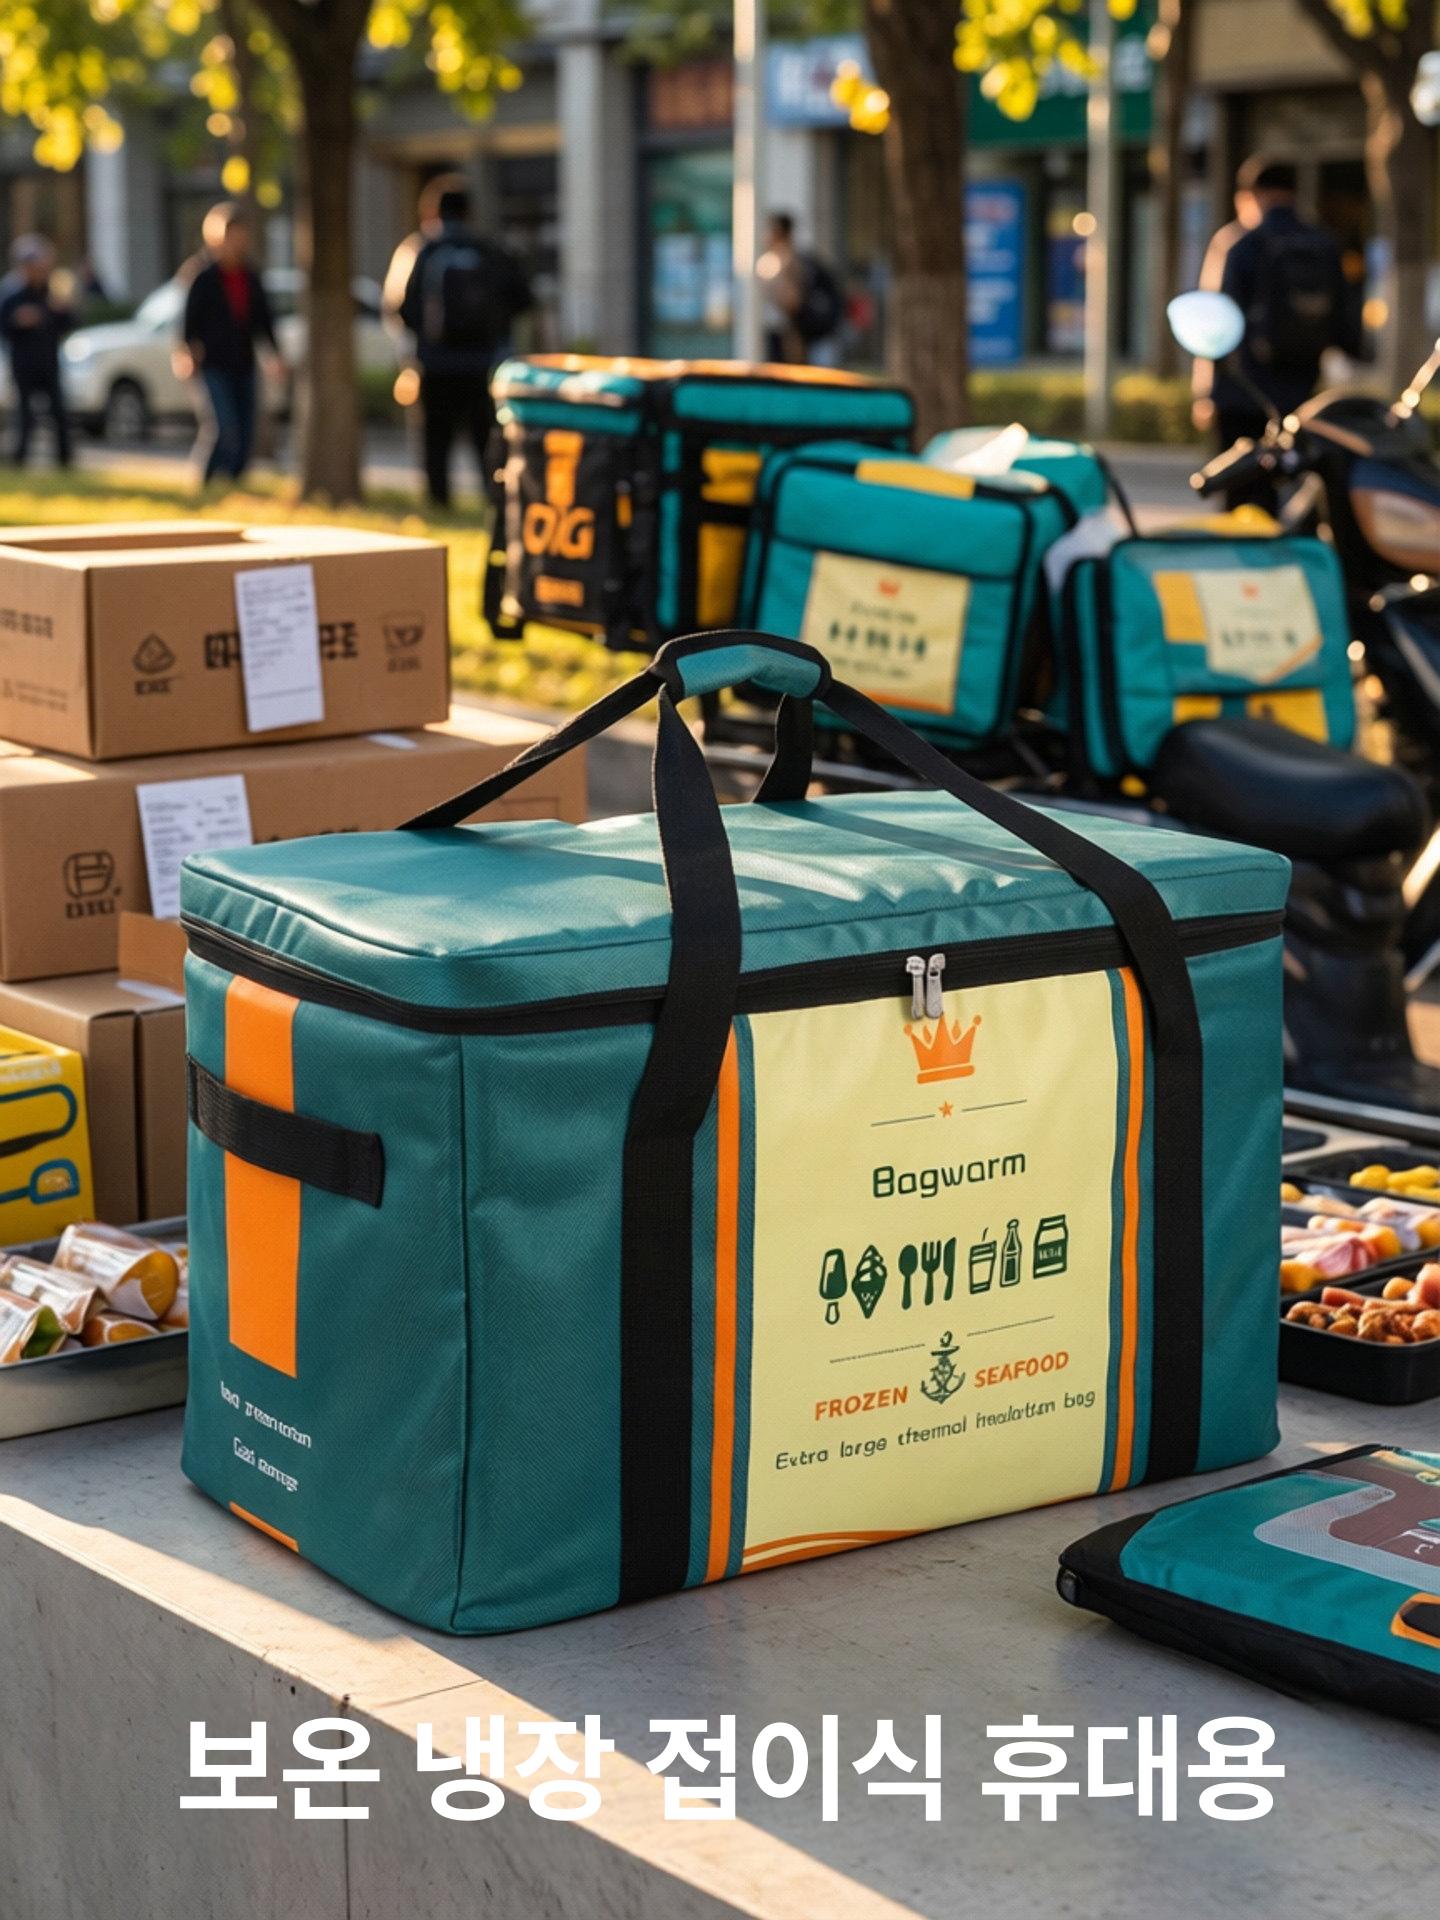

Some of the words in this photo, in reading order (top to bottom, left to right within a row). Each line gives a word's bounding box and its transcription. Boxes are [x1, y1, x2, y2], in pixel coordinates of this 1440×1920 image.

[873, 1153, 1026, 1198] Bagwarm
[814, 1385, 909, 1422] FROZEN
[973, 1350, 1070, 1389] SEAFOOD
[839, 1436, 888, 1458] large
